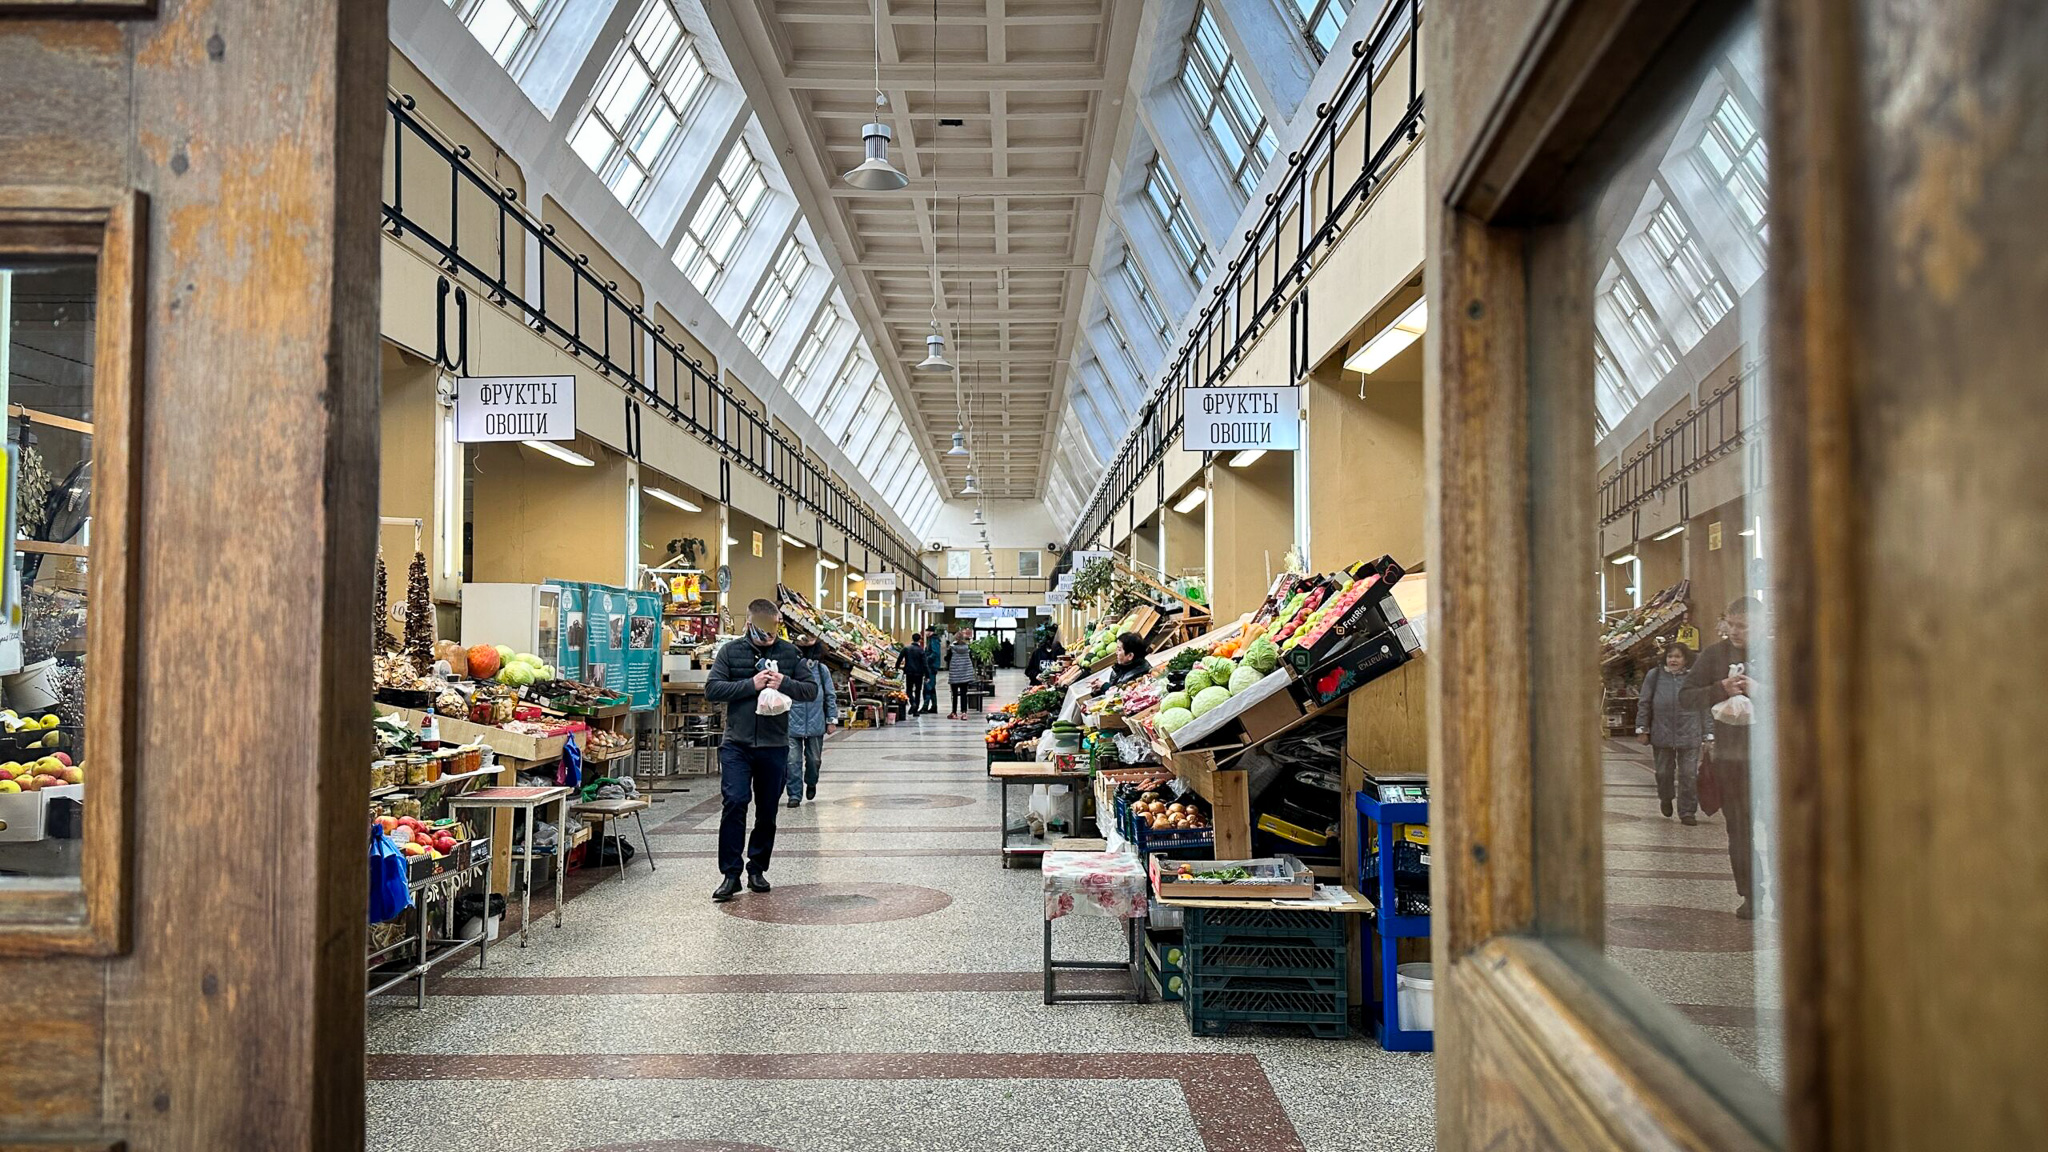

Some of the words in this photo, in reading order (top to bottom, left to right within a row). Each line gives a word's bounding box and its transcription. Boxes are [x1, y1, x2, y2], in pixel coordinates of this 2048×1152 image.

[480, 383, 558, 405] ФРУКТЫ
[1202, 393, 1279, 415] ФРУКТЫ
[485, 412, 548, 437] ОВОЩИ
[1210, 422, 1271, 446] ОВОЩИ
[1342, 604, 1367, 628] FrutRis
